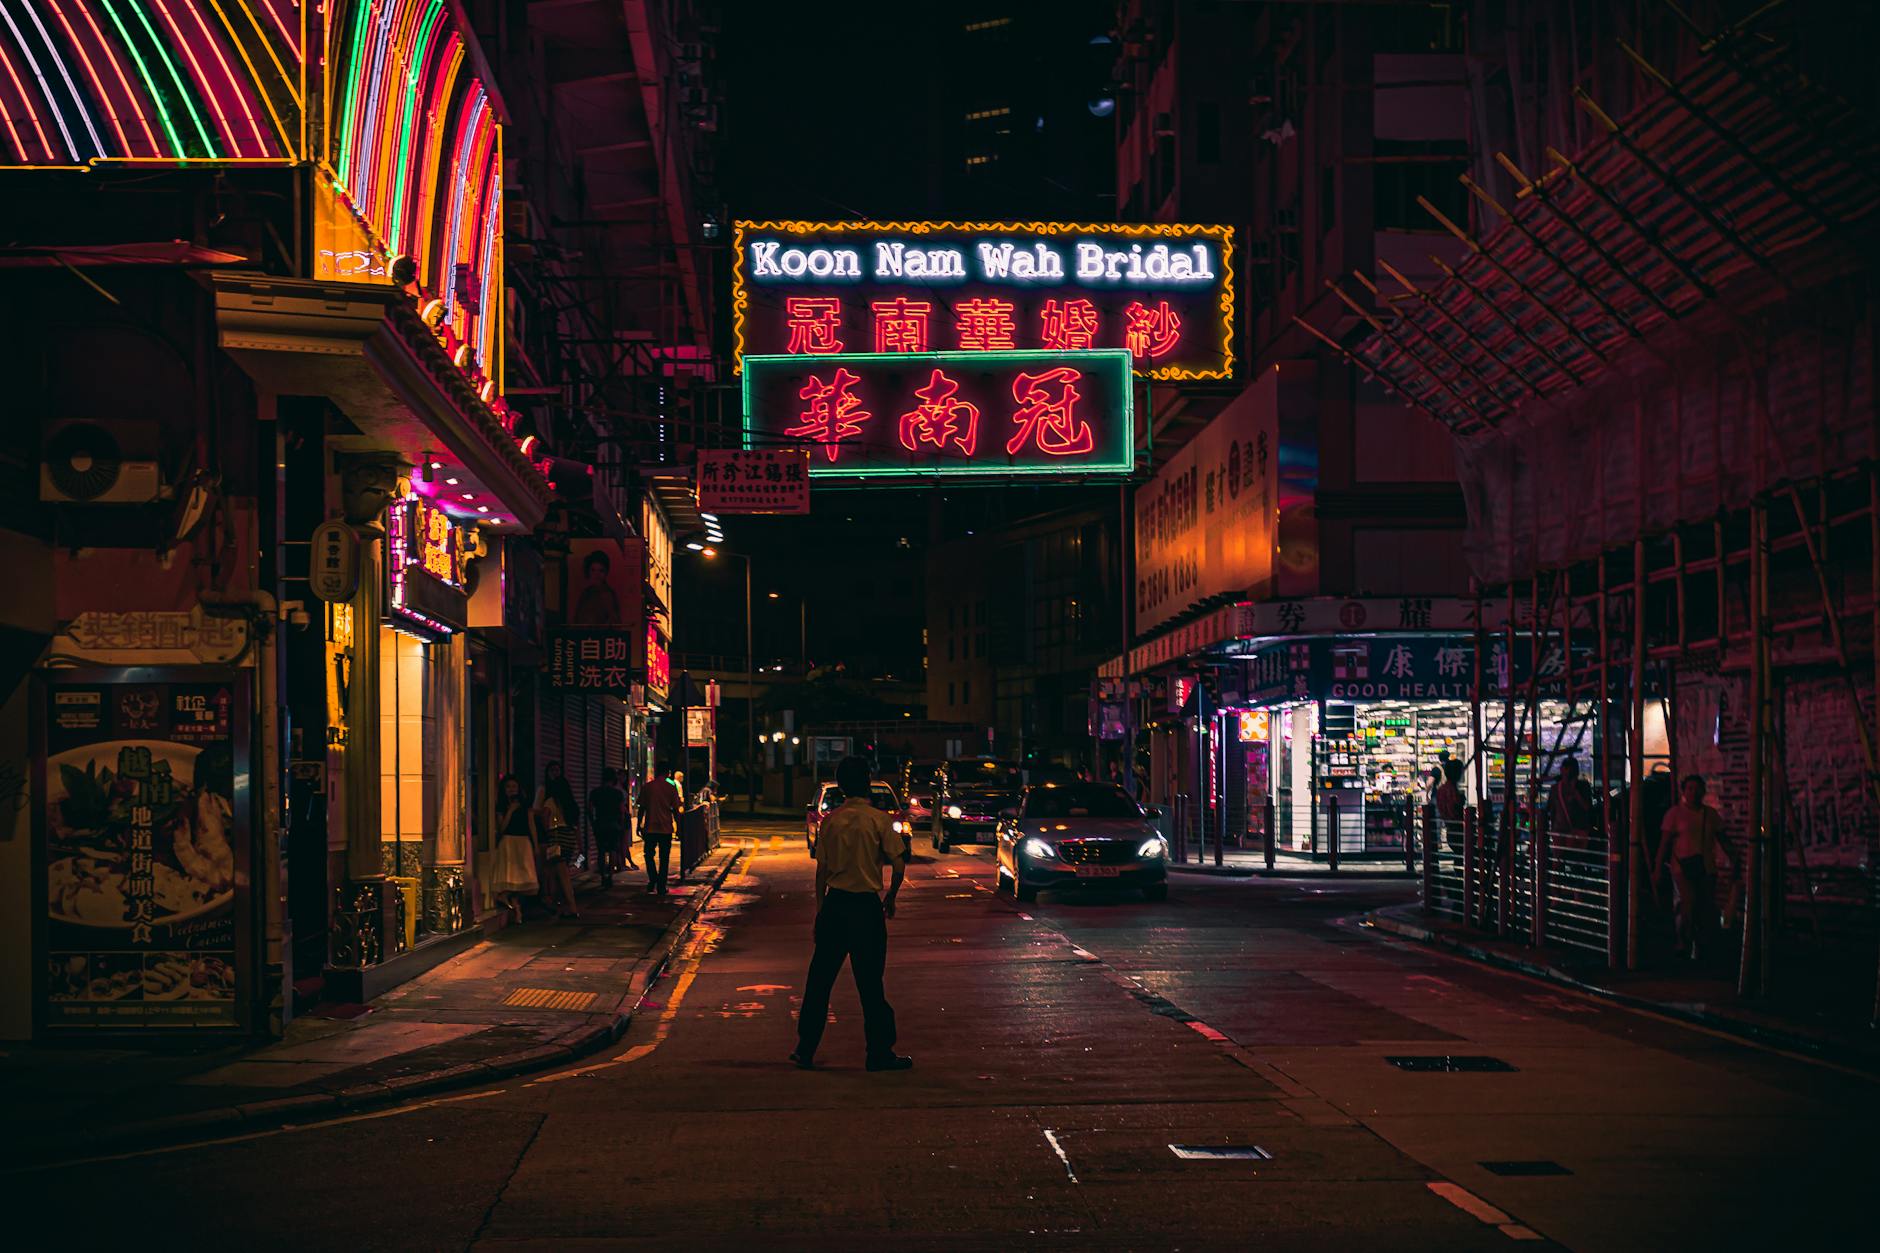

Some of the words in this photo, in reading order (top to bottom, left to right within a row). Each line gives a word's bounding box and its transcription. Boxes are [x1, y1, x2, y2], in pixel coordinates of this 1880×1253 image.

[751, 242, 861, 278] Koon
[875, 242, 966, 278] Nam
[977, 242, 1064, 279] Wah
[1077, 244, 1215, 280] Bridal
[786, 296, 1182, 359] 冠南華婚紗
[580, 636, 627, 661] 自助
[579, 664, 628, 688] 洗衣
[1332, 683, 1389, 698] GOOD
